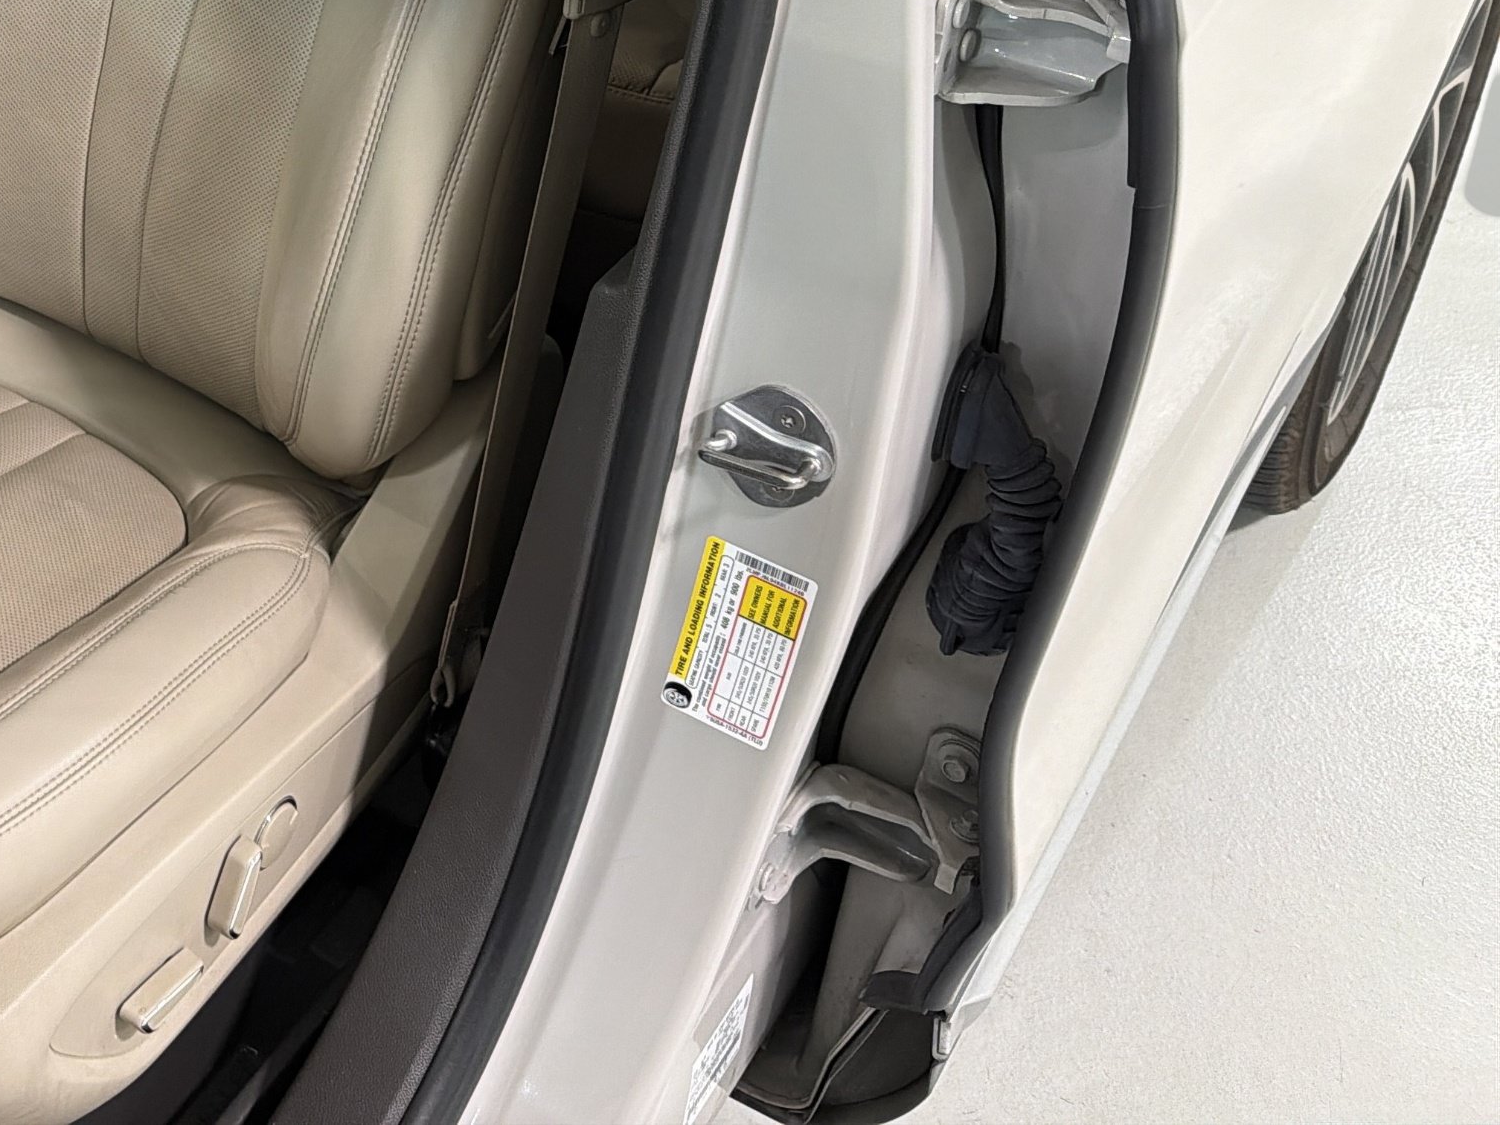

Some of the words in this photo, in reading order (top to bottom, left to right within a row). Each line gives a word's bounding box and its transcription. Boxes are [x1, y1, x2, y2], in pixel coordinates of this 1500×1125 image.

[730, 582, 740, 596] 900
[751, 585, 763, 608] OWNERS
[675, 655, 687, 675] TIRE
[682, 637, 693, 655] AND
[688, 600, 704, 636] LOADING
[699, 542, 720, 598] INFORMATION
[725, 606, 735, 615] kg
[729, 598, 735, 606] or
[748, 608, 756, 619] SEE
[760, 603, 772, 625] MANUAL
[766, 590, 775, 602] FOR
[772, 598, 787, 629] ADDITIONAL
[784, 599, 800, 636] INFORMATION
